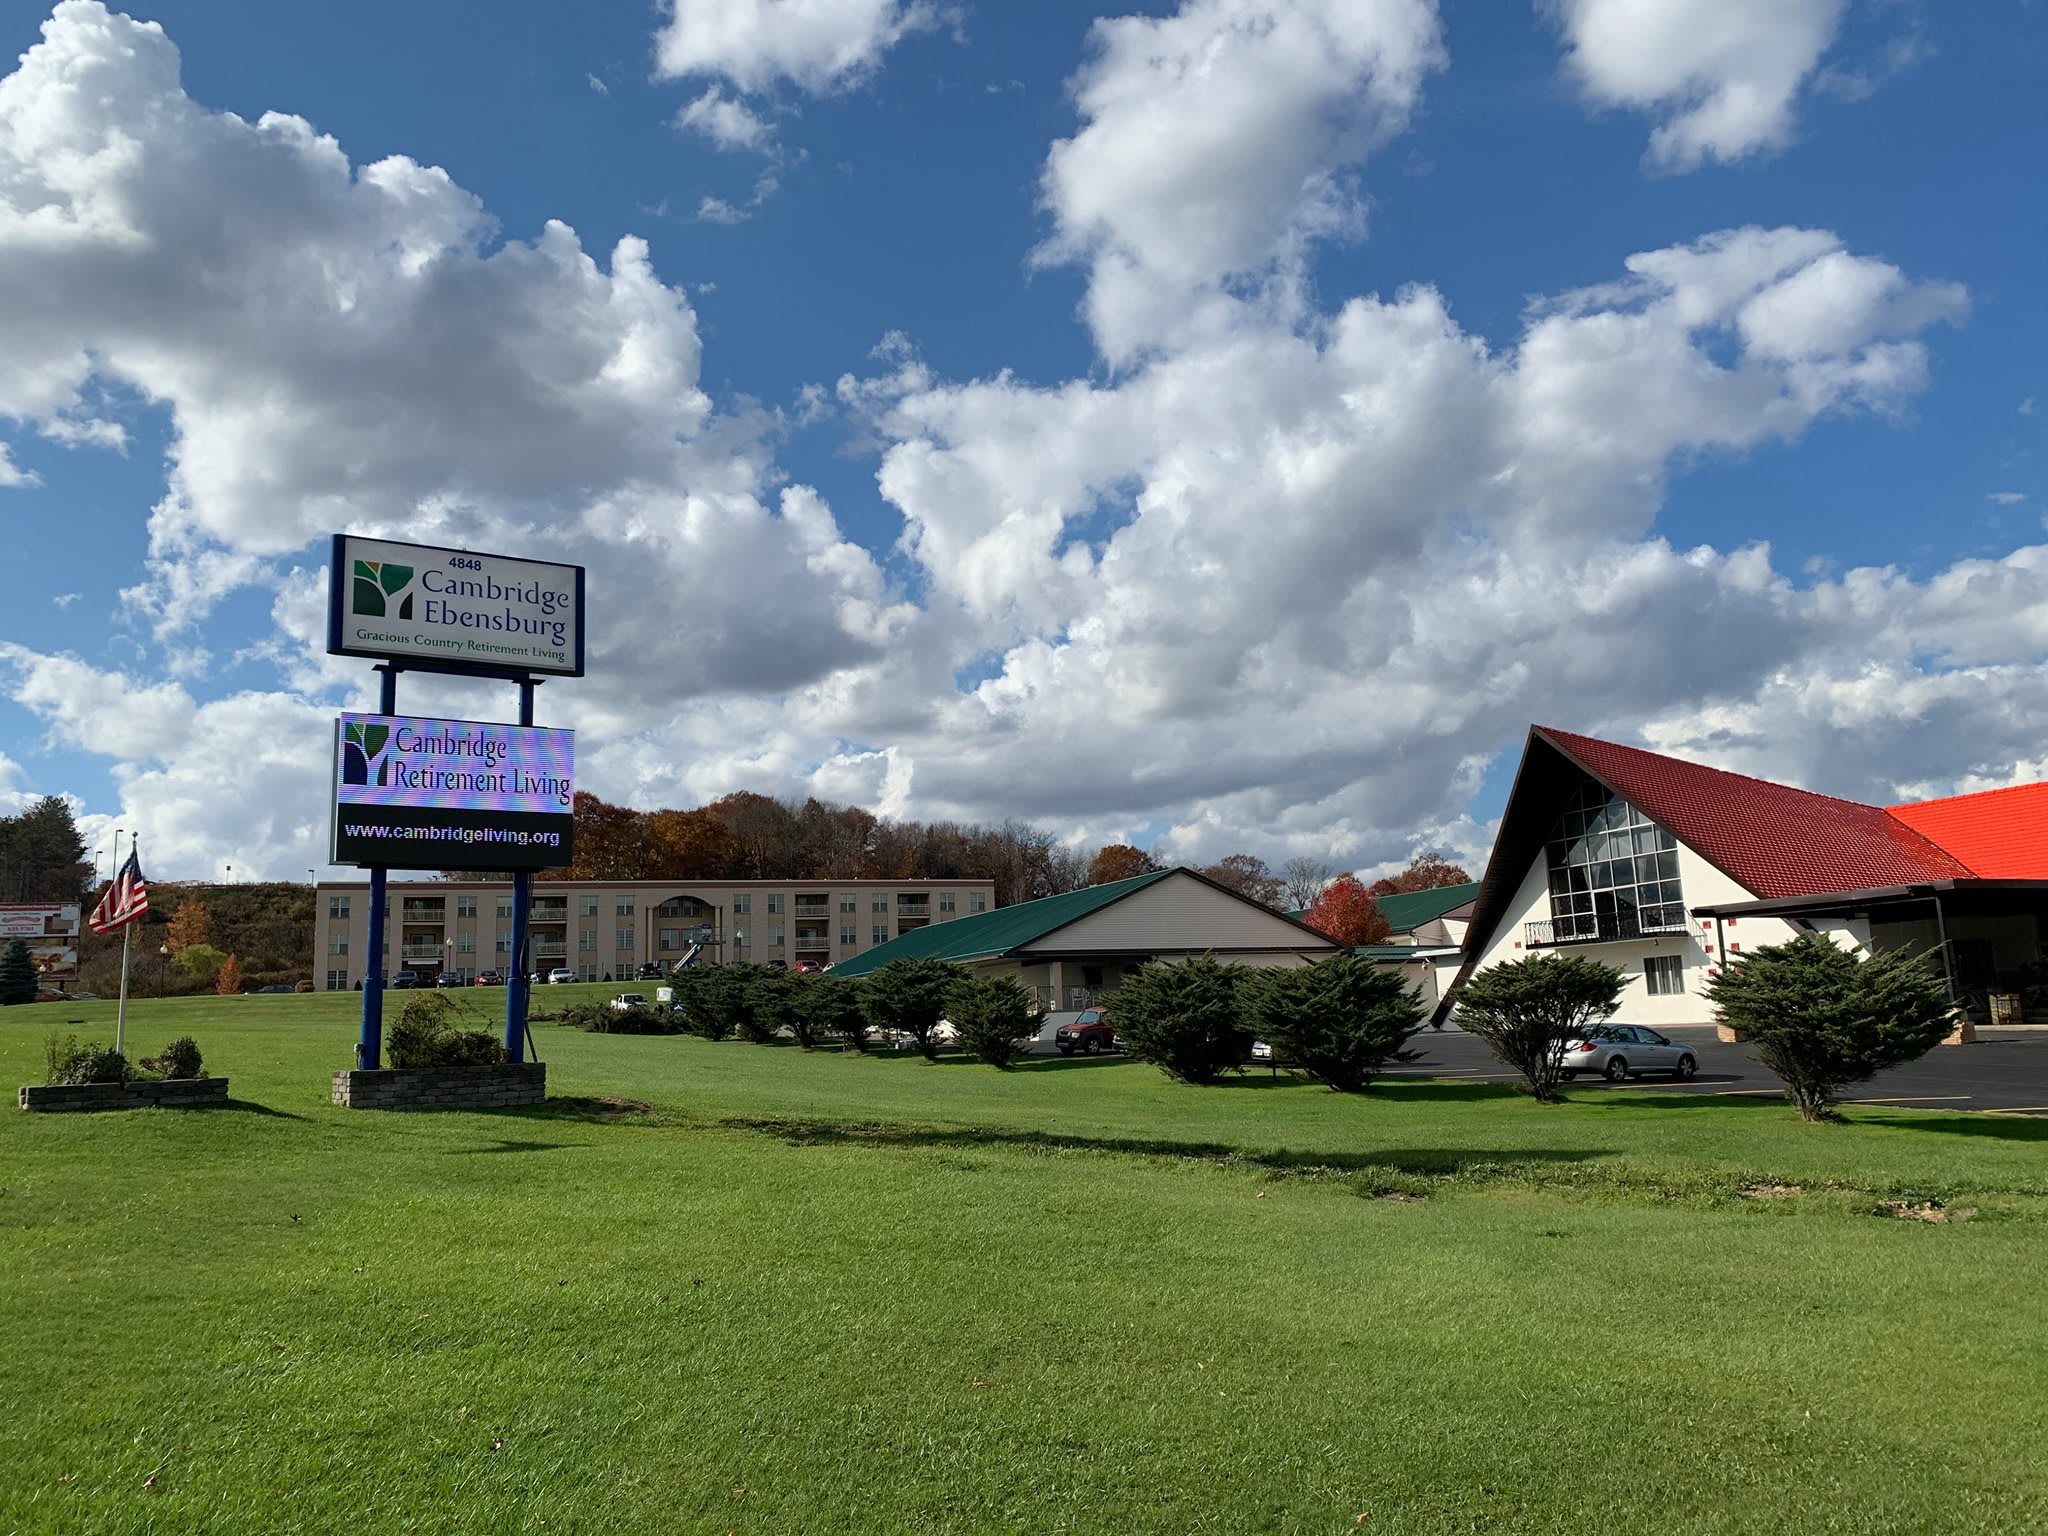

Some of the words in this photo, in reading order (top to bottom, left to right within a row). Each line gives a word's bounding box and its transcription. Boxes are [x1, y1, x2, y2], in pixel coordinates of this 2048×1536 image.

[448, 556, 482, 571] 4848
[421, 570, 569, 615] Cambridge
[425, 600, 566, 646] Ebensburg
[356, 628, 410, 643] Gracious
[414, 634, 463, 652] Country
[467, 639, 528, 656] Retirement
[532, 646, 565, 663] Living
[395, 727, 507, 767] Cambridge
[394, 760, 506, 793] Retirement
[513, 768, 570, 806] Living
[344, 824, 560, 846] www.cambridgeliving.org
